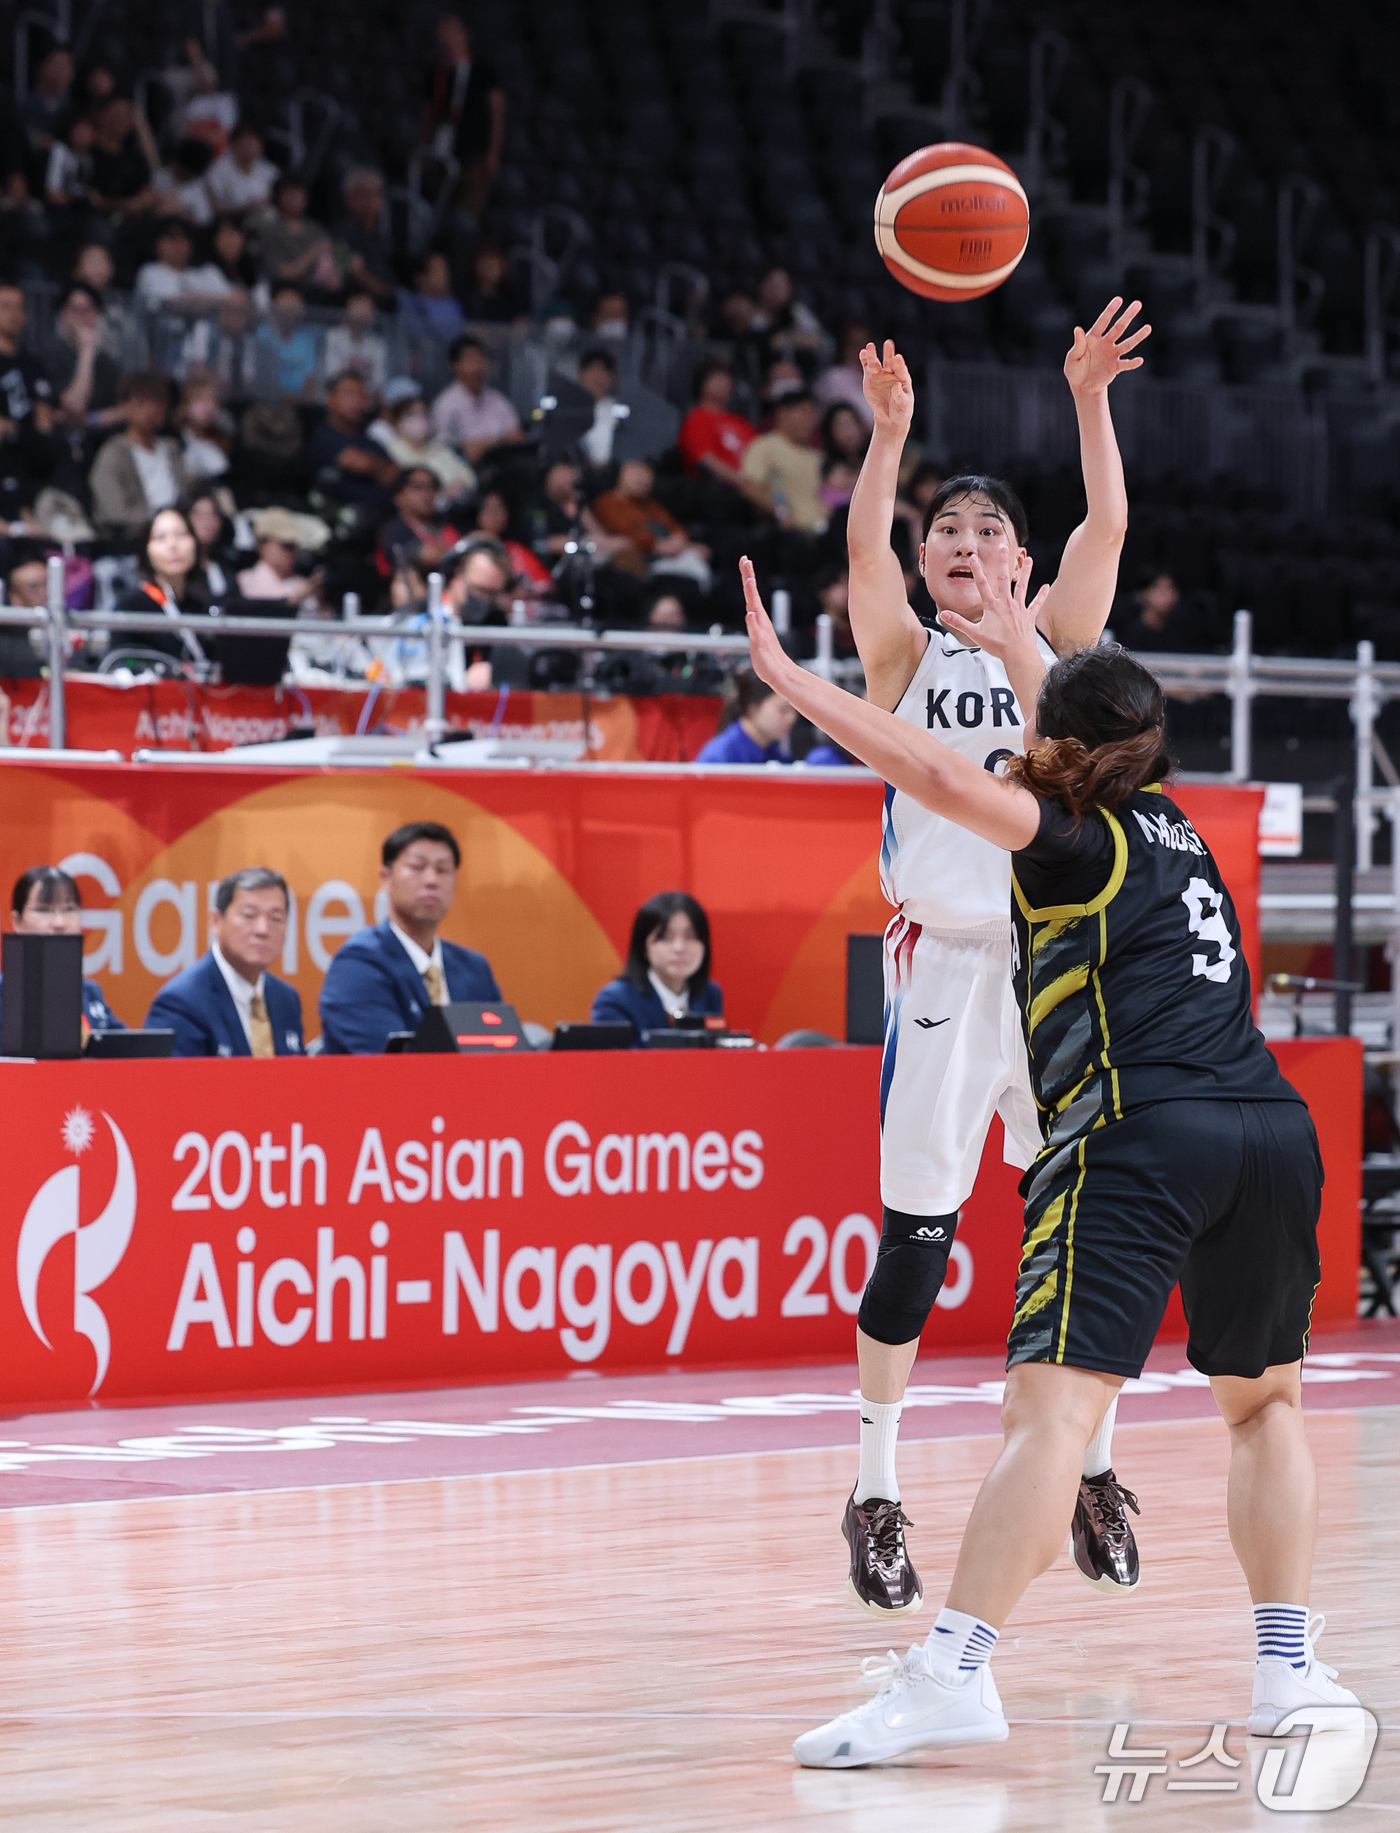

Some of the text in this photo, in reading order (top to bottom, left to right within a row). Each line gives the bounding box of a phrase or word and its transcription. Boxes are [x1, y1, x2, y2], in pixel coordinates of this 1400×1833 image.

[926, 688, 1020, 728] KOR
[58, 852, 391, 976] Gae
[1181, 877, 1237, 984] 9
[171, 1116, 764, 1211] 20th Asian Games
[166, 1209, 974, 1362] Aichi-Nagoya 206
